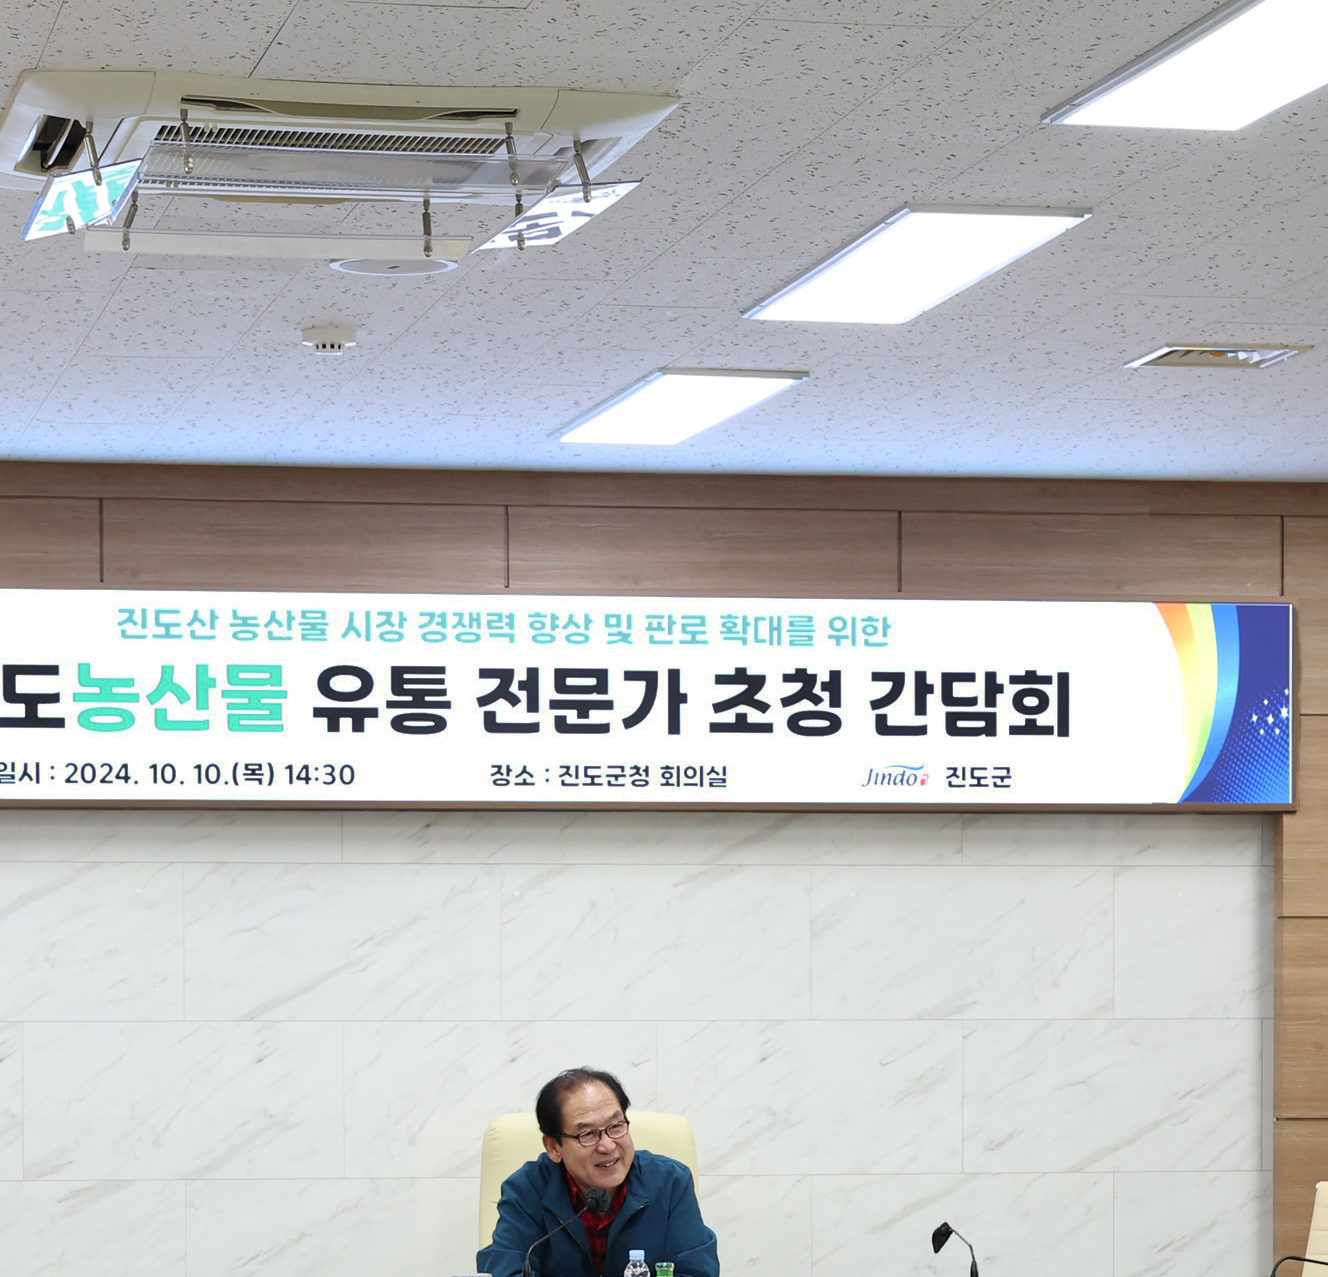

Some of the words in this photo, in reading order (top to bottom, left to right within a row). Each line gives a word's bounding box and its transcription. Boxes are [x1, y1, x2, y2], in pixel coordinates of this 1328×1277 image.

[116, 607, 219, 641] 진도산
[228, 608, 330, 642] 농산물
[340, 609, 408, 644] 시장
[417, 609, 517, 644] 경쟁력
[527, 610, 594, 645] 향상
[603, 612, 635, 646] 및
[644, 613, 710, 646] 판로
[718, 612, 817, 648] 확대를
[826, 614, 892, 648] 위한
[312, 663, 452, 736] 유통
[475, 666, 688, 736] 전문가
[708, 666, 843, 737] 초청
[868, 669, 1070, 738] 간담회
[63, 761, 138, 785] 2024.
[148, 762, 183, 785] 10.
[192, 761, 275, 787] 10.(목)
[284, 763, 356, 786] 14:30
[489, 763, 536, 787] 장소
[558, 763, 650, 788] 진도군청
[659, 764, 727, 788] 회의실
[861, 766, 921, 789] Jindo
[945, 765, 1013, 789] 진도군
